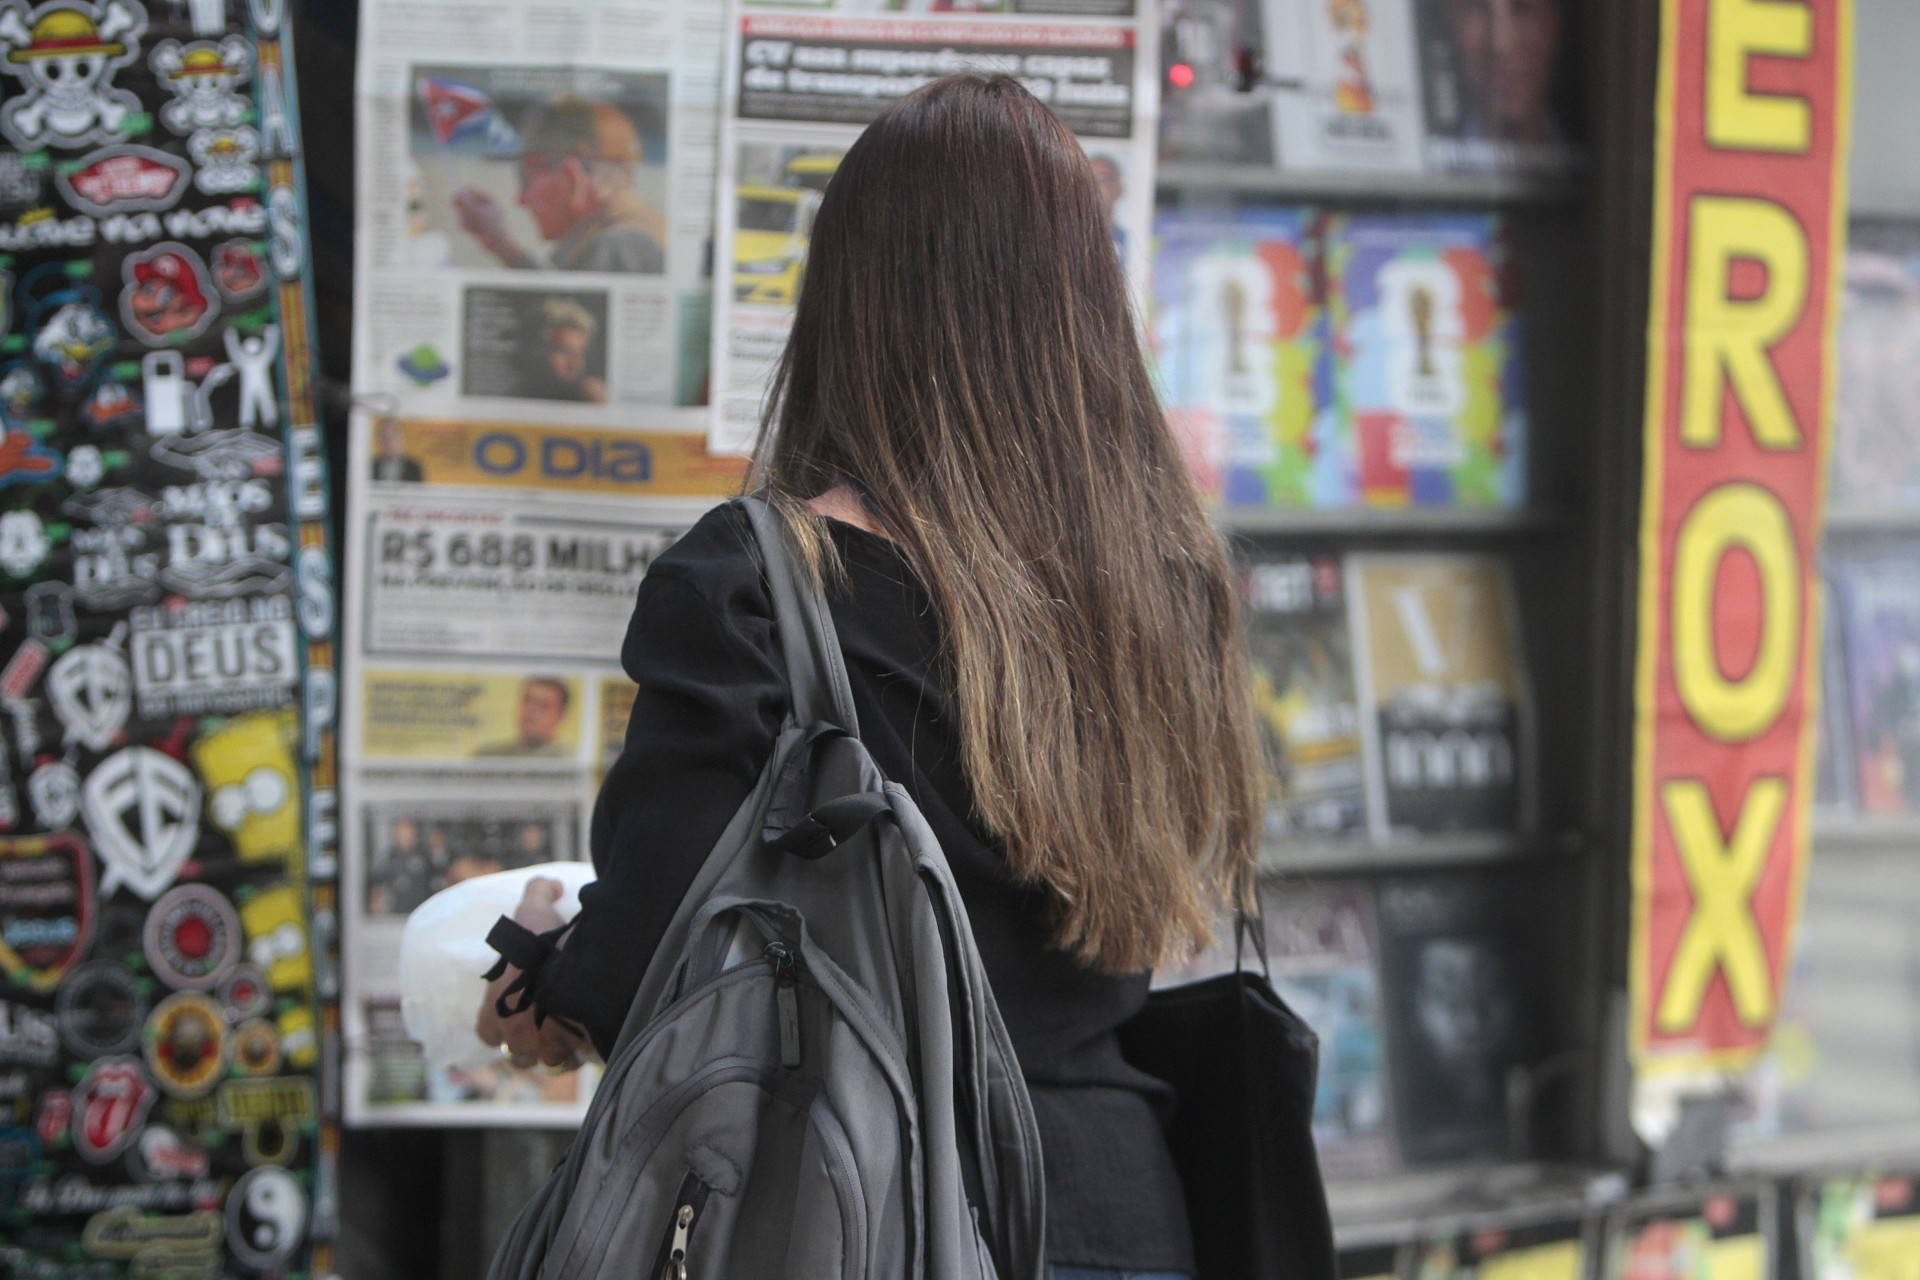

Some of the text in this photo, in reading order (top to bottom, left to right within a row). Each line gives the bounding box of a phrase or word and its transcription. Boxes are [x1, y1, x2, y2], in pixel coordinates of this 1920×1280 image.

[473, 431, 528, 476] O
[448, 532, 537, 571] 688
[145, 626, 282, 684] DEUS
